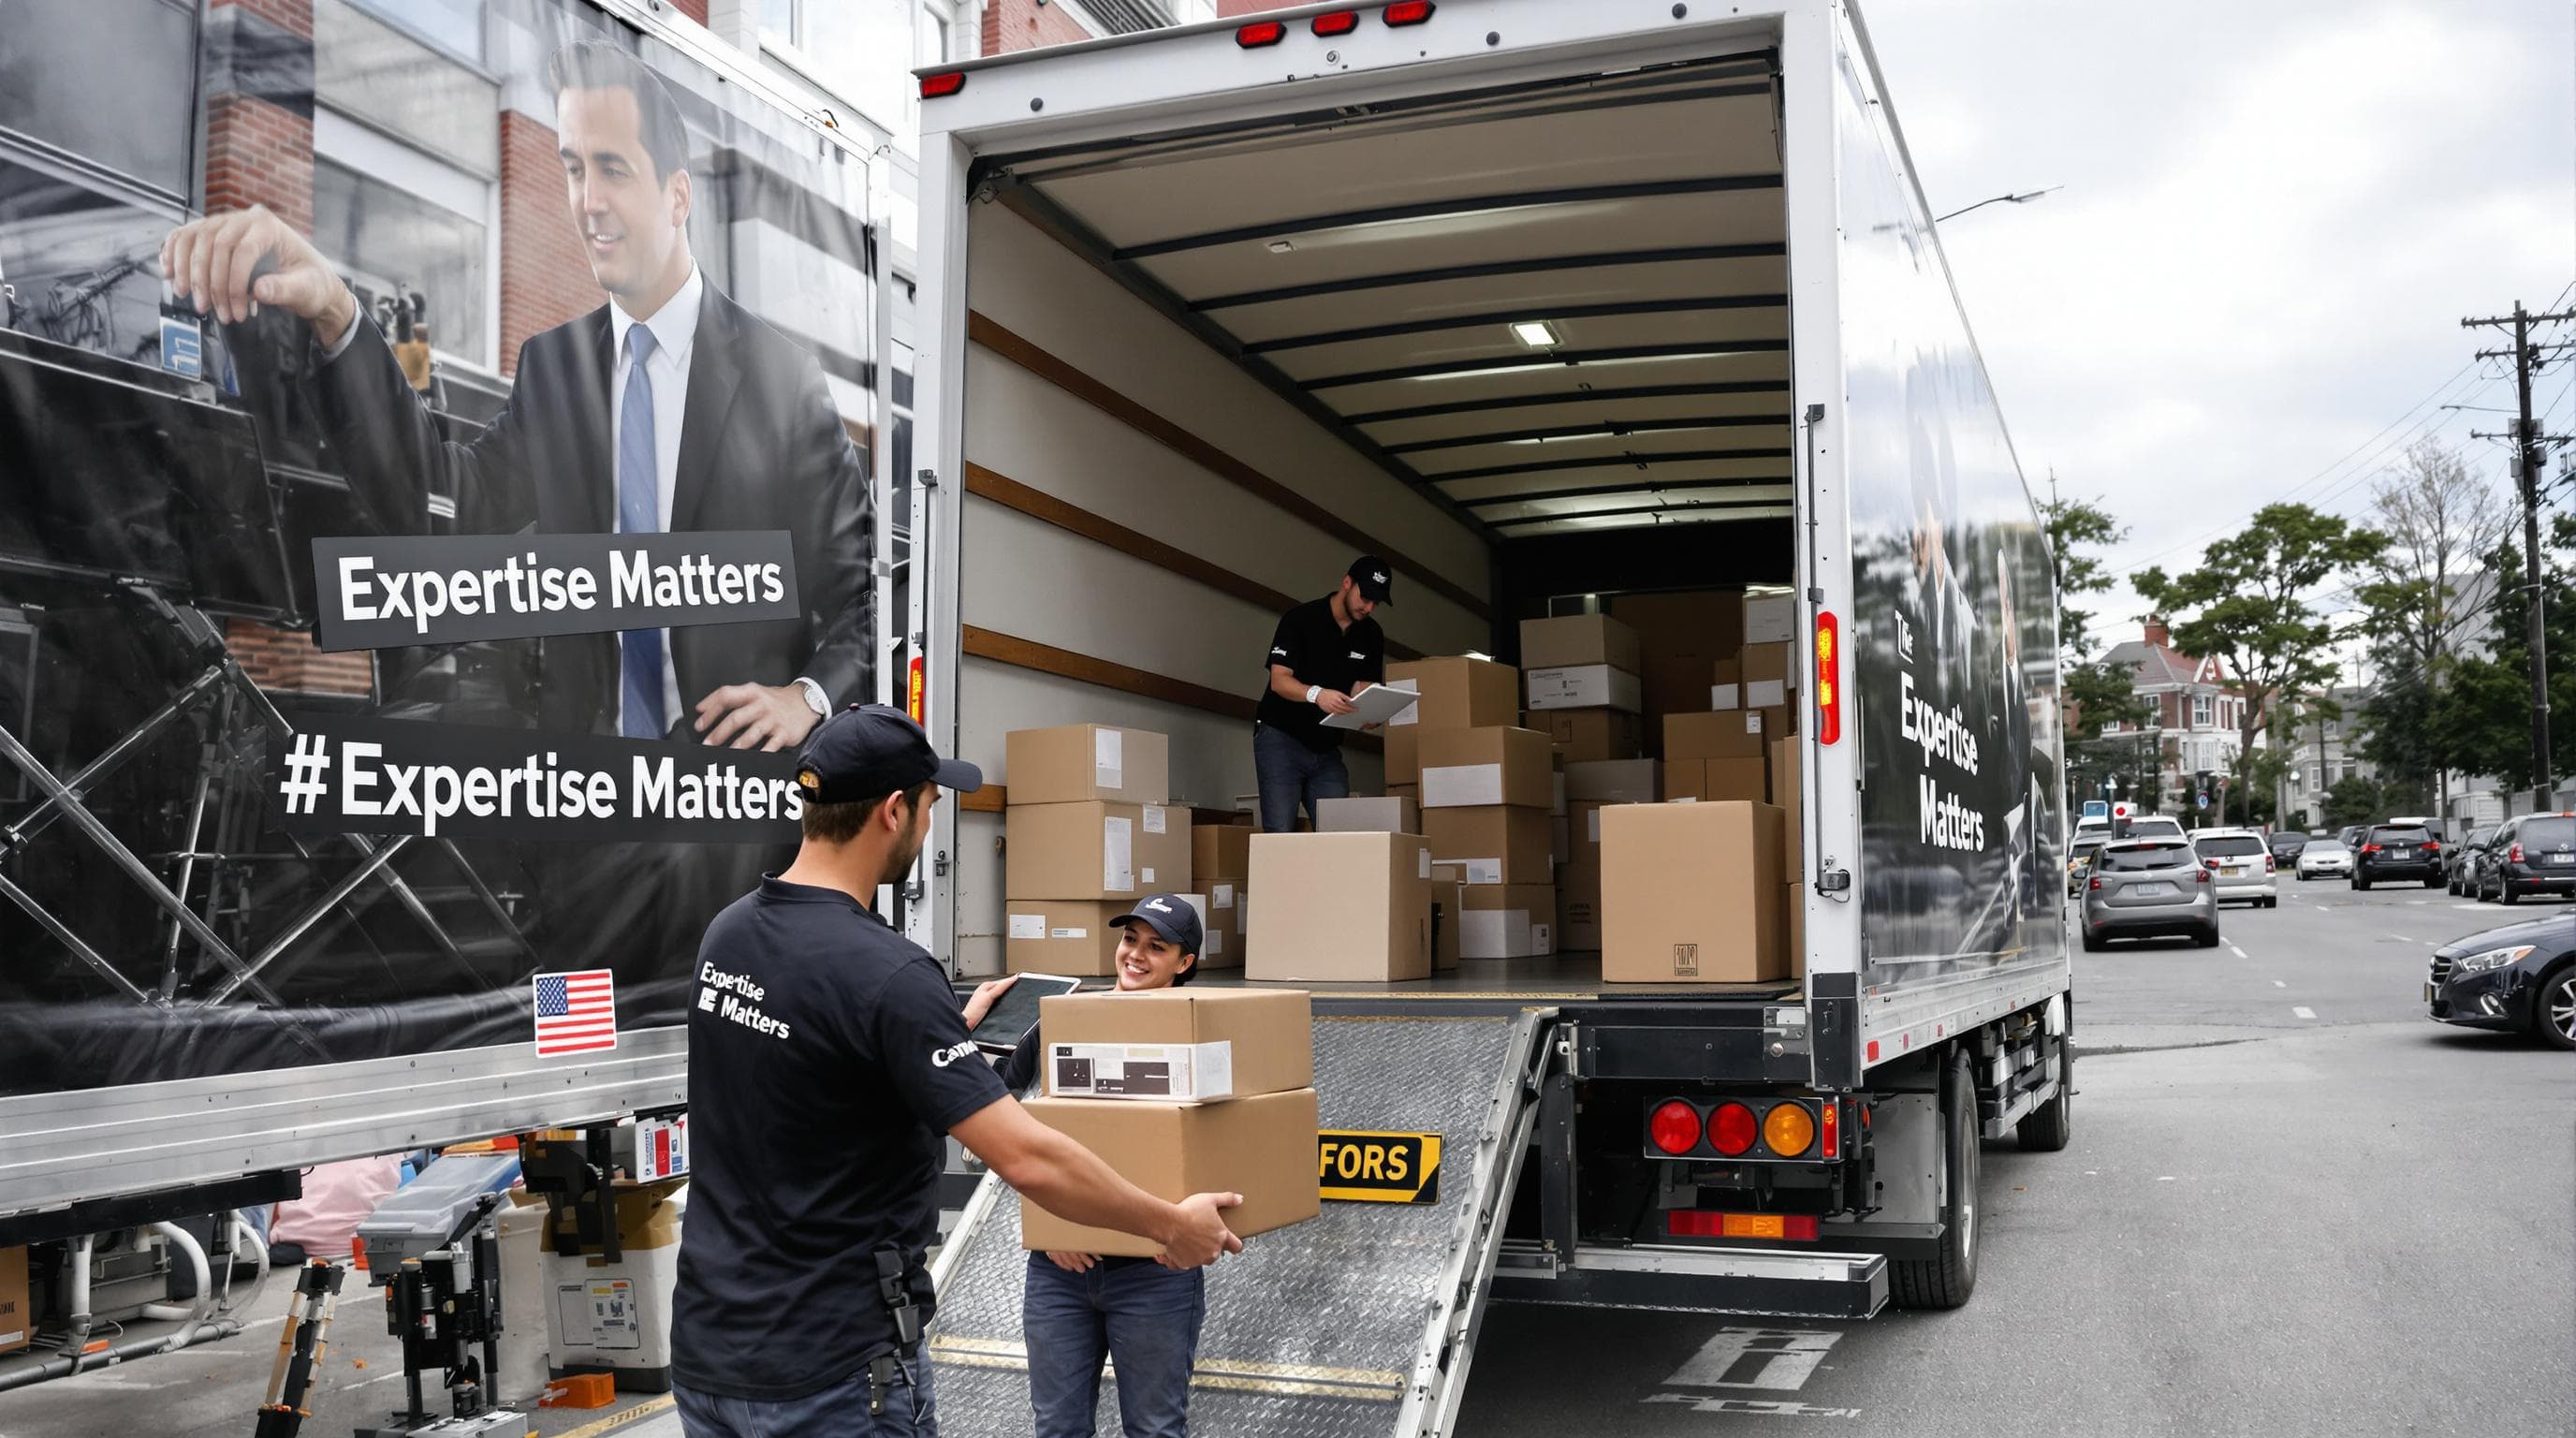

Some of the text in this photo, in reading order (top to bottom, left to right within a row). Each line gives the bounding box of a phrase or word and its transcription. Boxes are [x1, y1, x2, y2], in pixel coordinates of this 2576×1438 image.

[338, 550, 784, 634] Expertise Matters
[1901, 670, 1978, 776] Expertise
[280, 733, 803, 838] #Expertise Matters
[1920, 773, 1984, 852] Matters
[699, 961, 765, 1002] Expertise
[721, 995, 790, 1039] Matters
[1319, 1142, 1409, 1181] FORS
